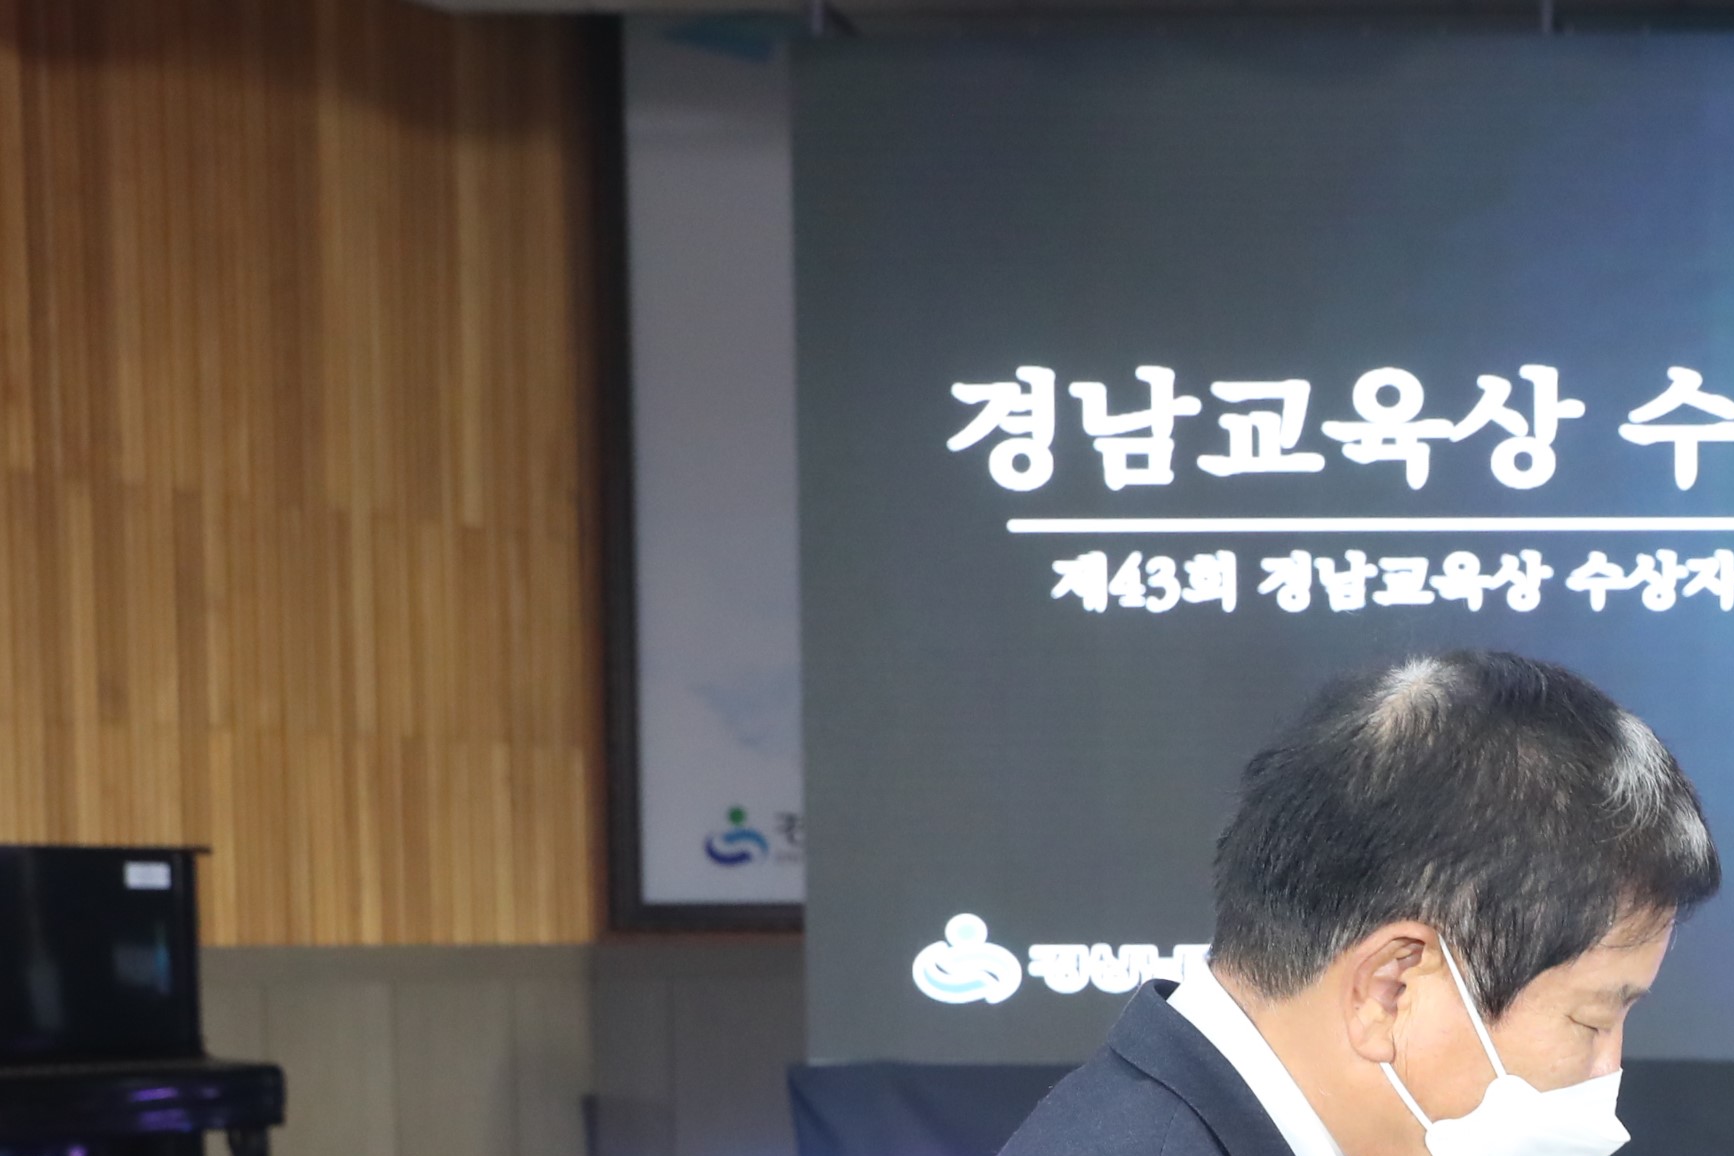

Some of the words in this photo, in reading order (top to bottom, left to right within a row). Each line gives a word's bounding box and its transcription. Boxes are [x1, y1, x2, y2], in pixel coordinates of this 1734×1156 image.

[947, 365, 1585, 491] 경남교육상
[1052, 550, 1236, 612] 제43회
[1258, 549, 1554, 610] 경남교육상
